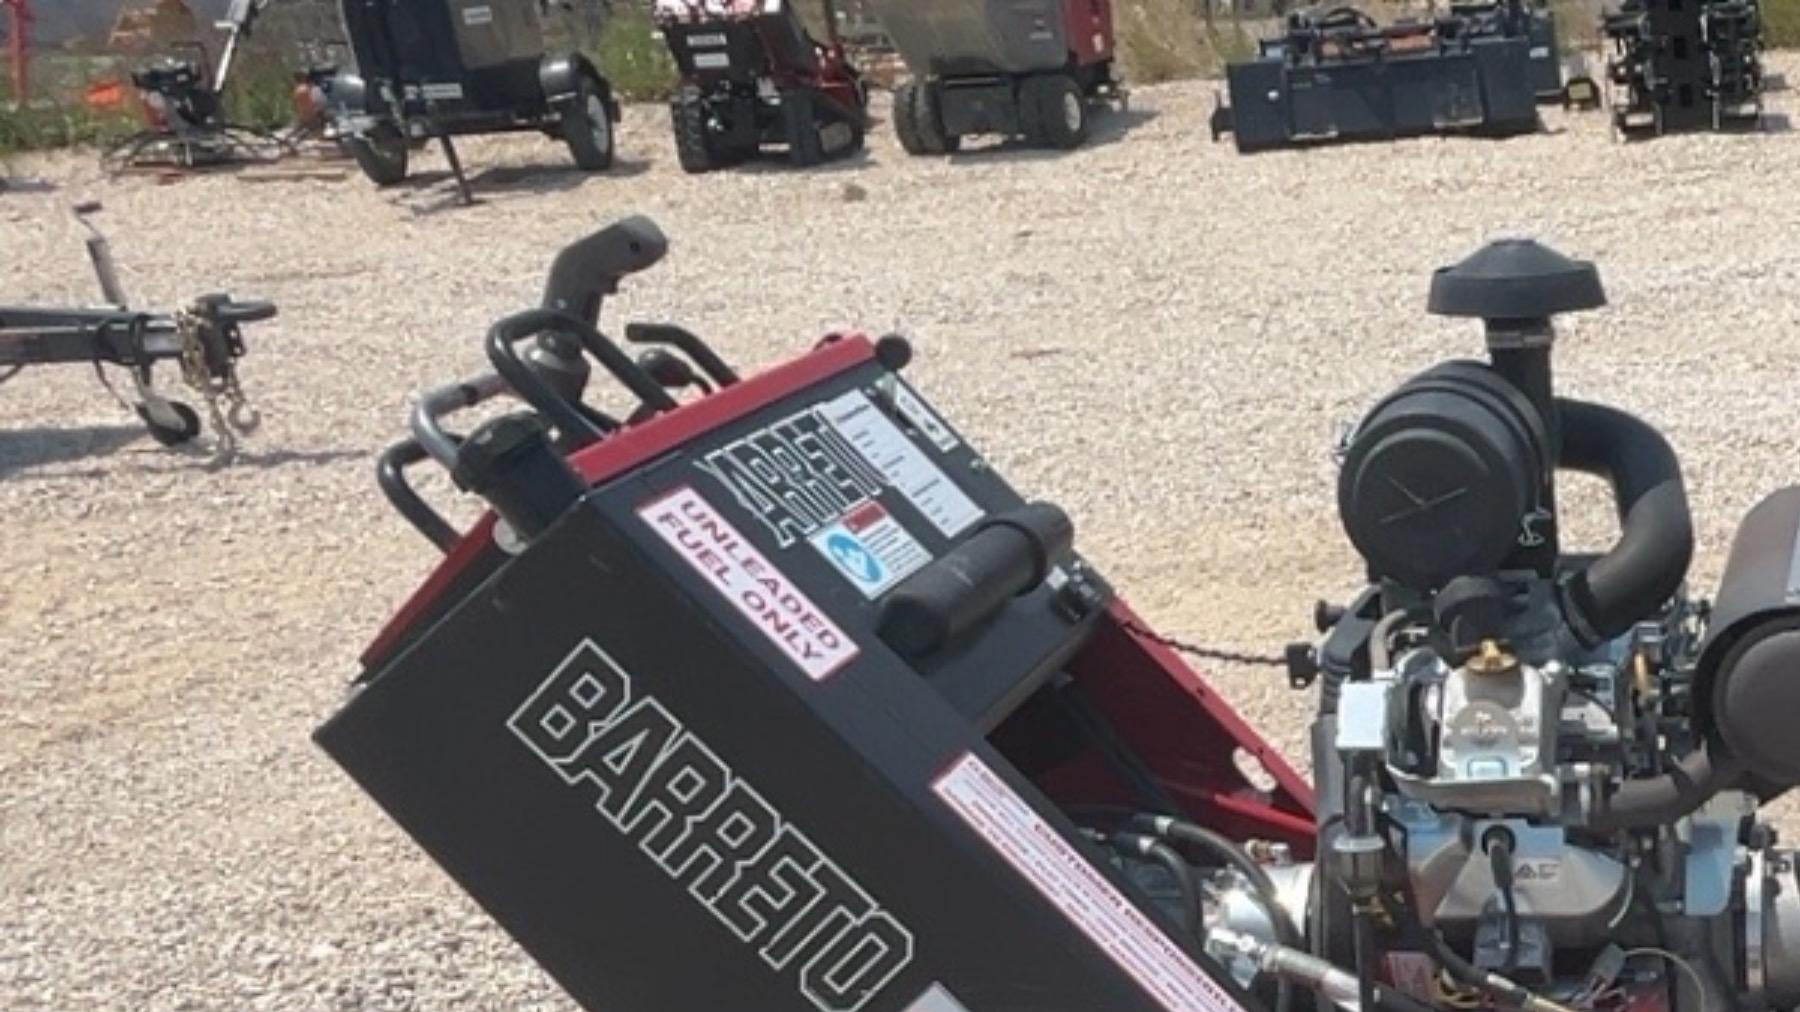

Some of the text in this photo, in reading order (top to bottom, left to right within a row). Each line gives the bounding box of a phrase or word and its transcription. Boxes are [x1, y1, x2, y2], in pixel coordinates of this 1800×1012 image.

[656, 511, 824, 662] FUEL ONLY
[681, 500, 842, 650] UNLEADED
